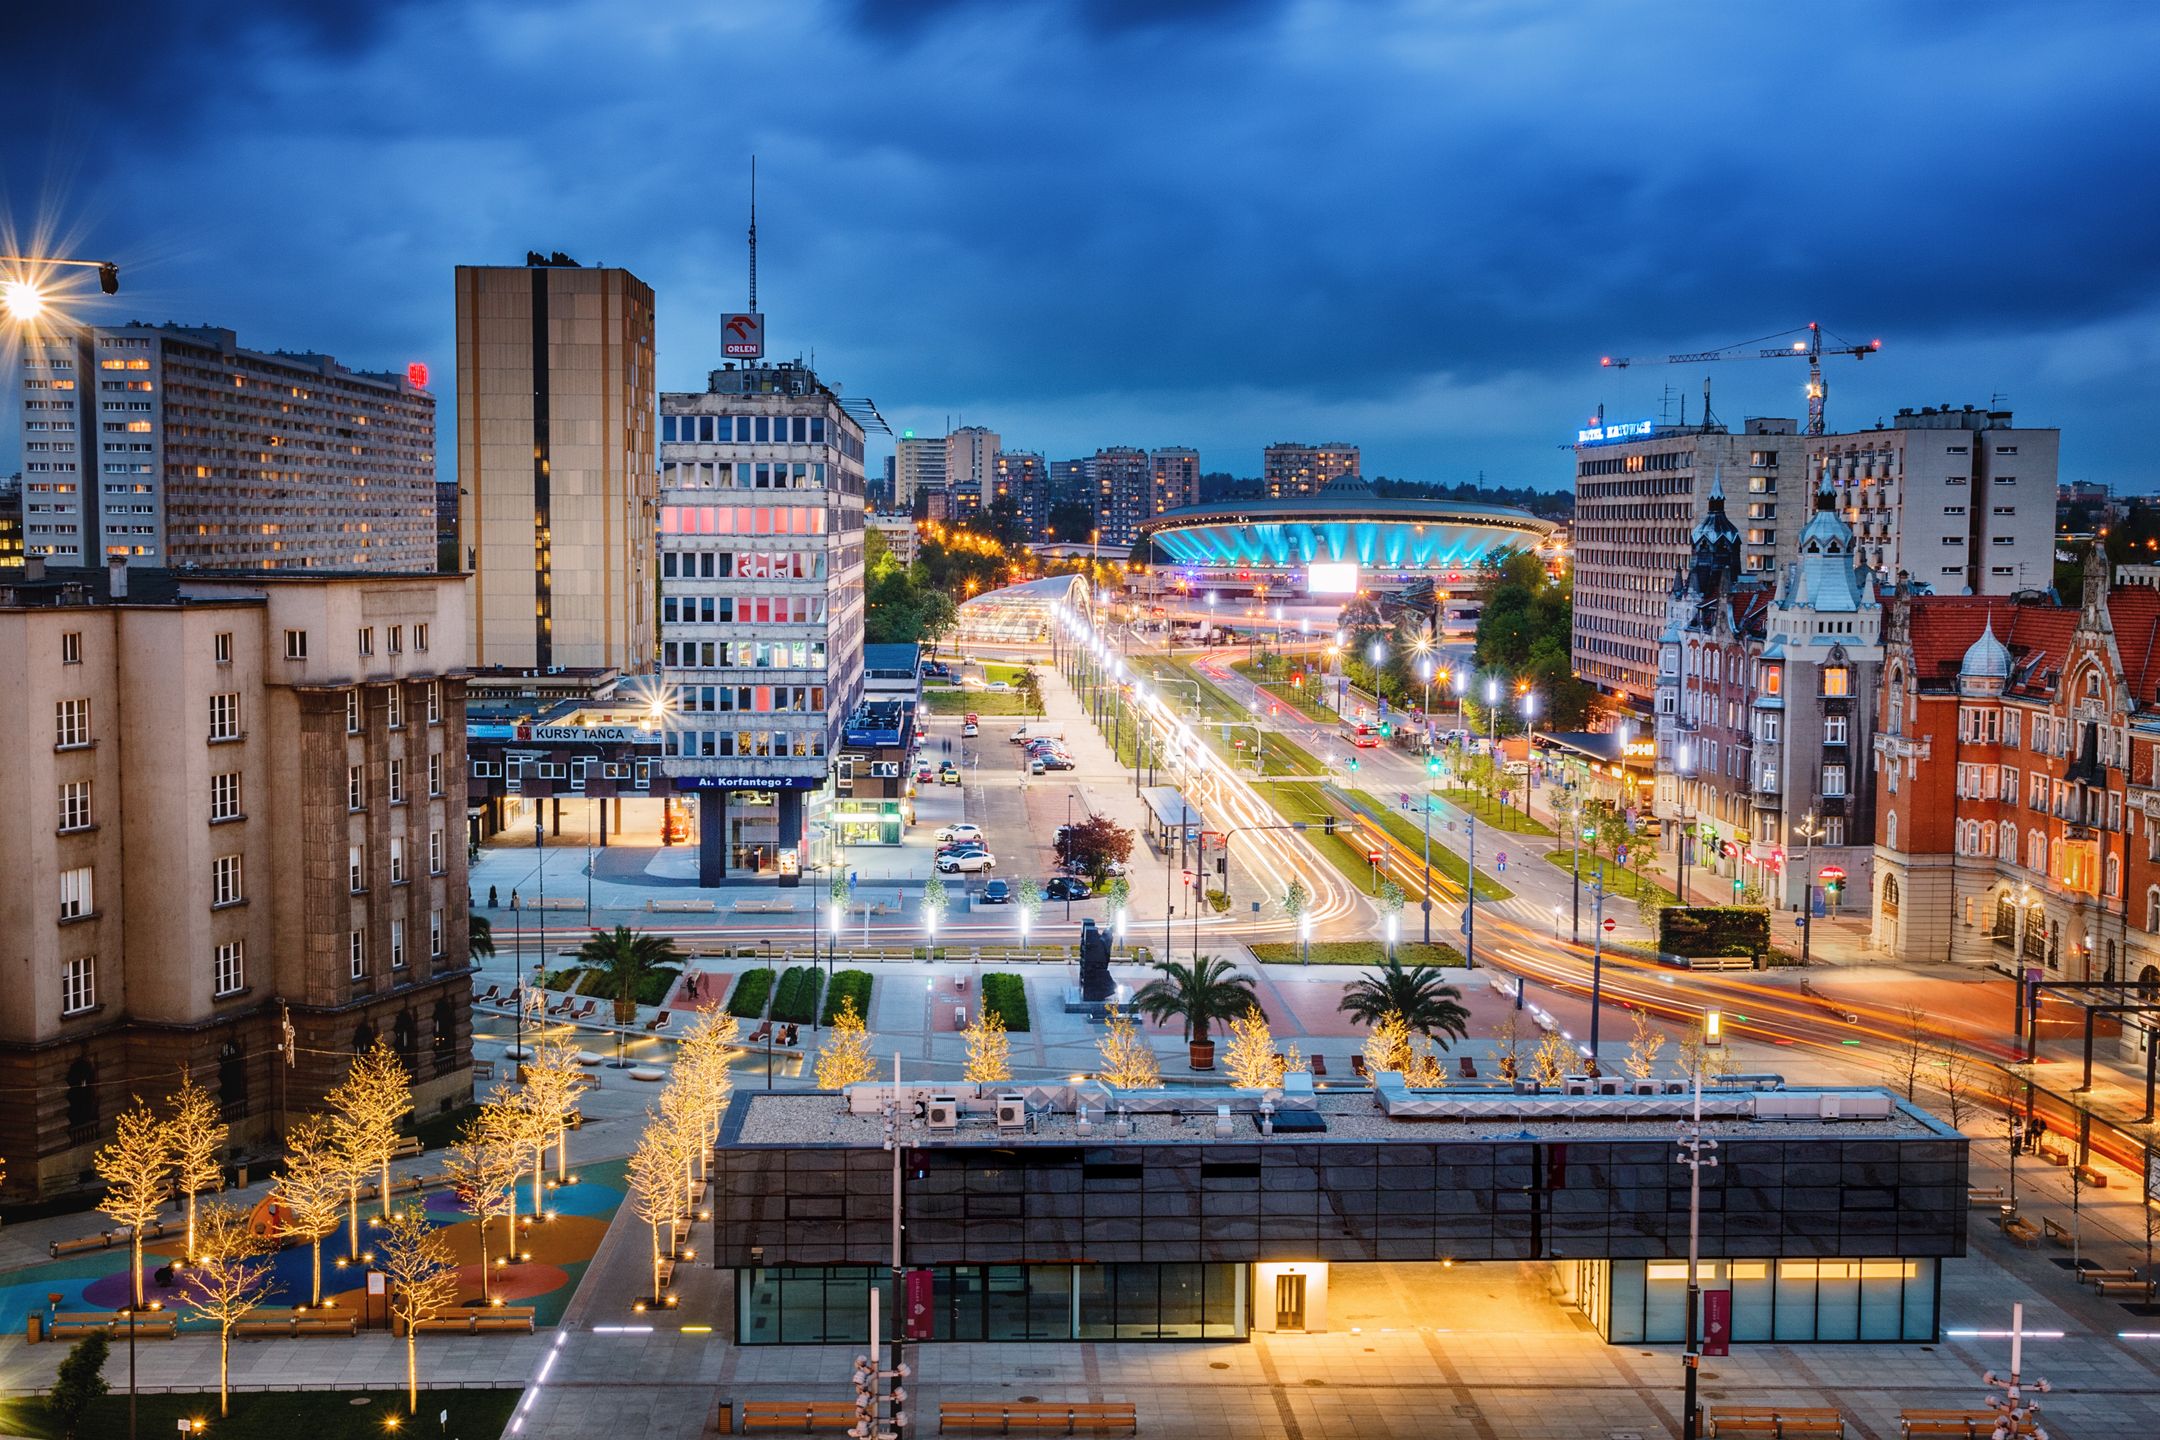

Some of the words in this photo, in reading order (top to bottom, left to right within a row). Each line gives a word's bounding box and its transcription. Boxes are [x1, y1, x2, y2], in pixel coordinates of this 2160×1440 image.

[727, 345, 757, 353] ORLEN
[1578, 428, 1604, 442] HOTEL
[1606, 421, 1651, 438] KATOWICE
[536, 728, 579, 739] KURSY
[583, 727, 625, 739] TAŃCA
[718, 777, 782, 788] Korfantego
[785, 778, 793, 786] 2
